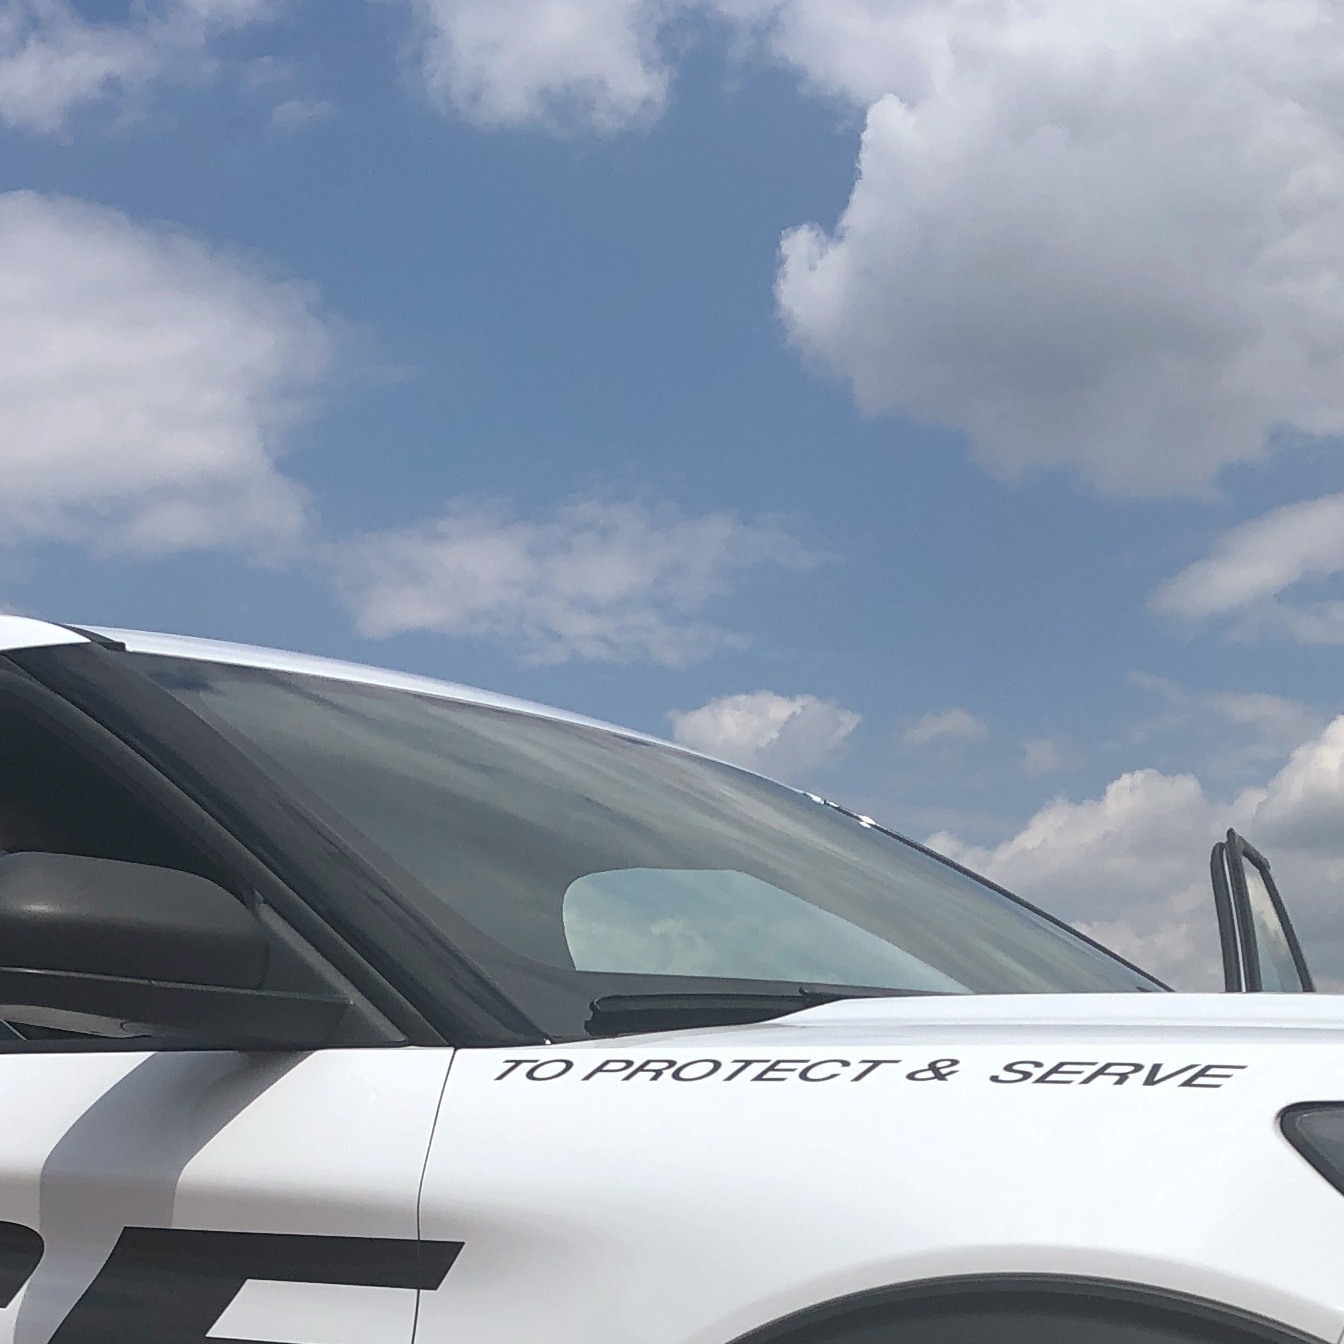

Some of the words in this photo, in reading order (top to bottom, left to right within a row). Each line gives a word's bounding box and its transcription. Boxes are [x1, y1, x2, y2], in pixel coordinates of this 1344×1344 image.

[494, 1058, 575, 1082] TO
[581, 1058, 902, 1083] PROTECT
[906, 1058, 960, 1082] &
[989, 1060, 1248, 1089] SERVE
